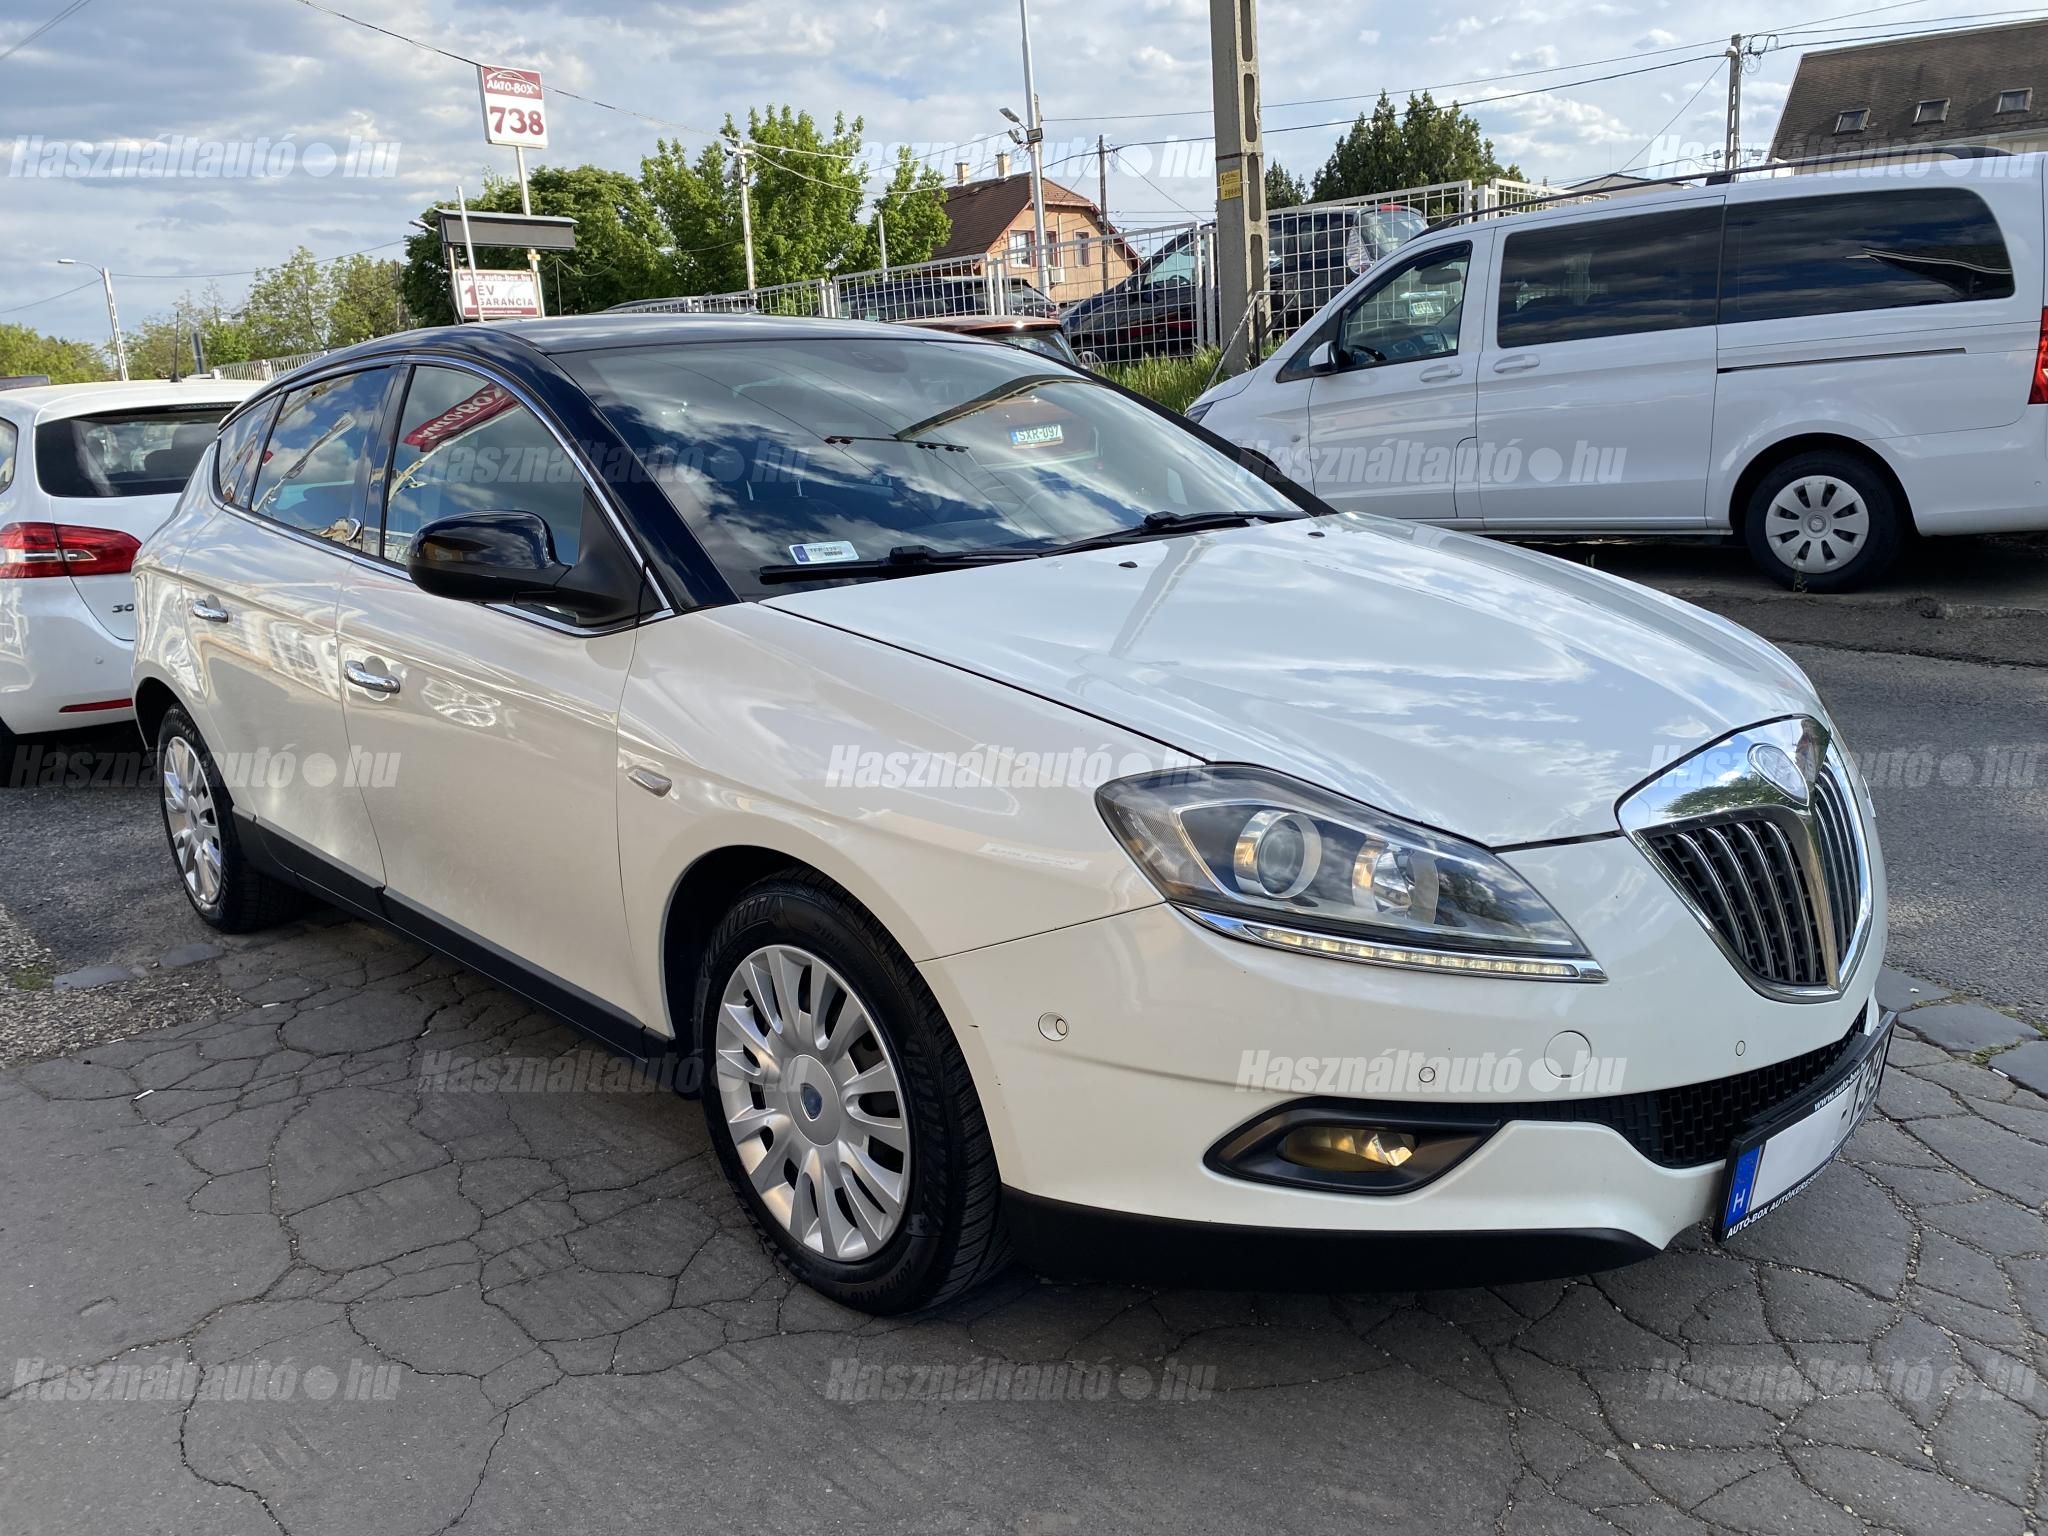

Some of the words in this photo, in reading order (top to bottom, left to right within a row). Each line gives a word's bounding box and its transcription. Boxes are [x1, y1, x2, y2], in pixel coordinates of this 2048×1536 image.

[486, 79, 534, 95] AUTO-BOX
[489, 105, 545, 136] 738
[1732, 1187, 1746, 1213] H
